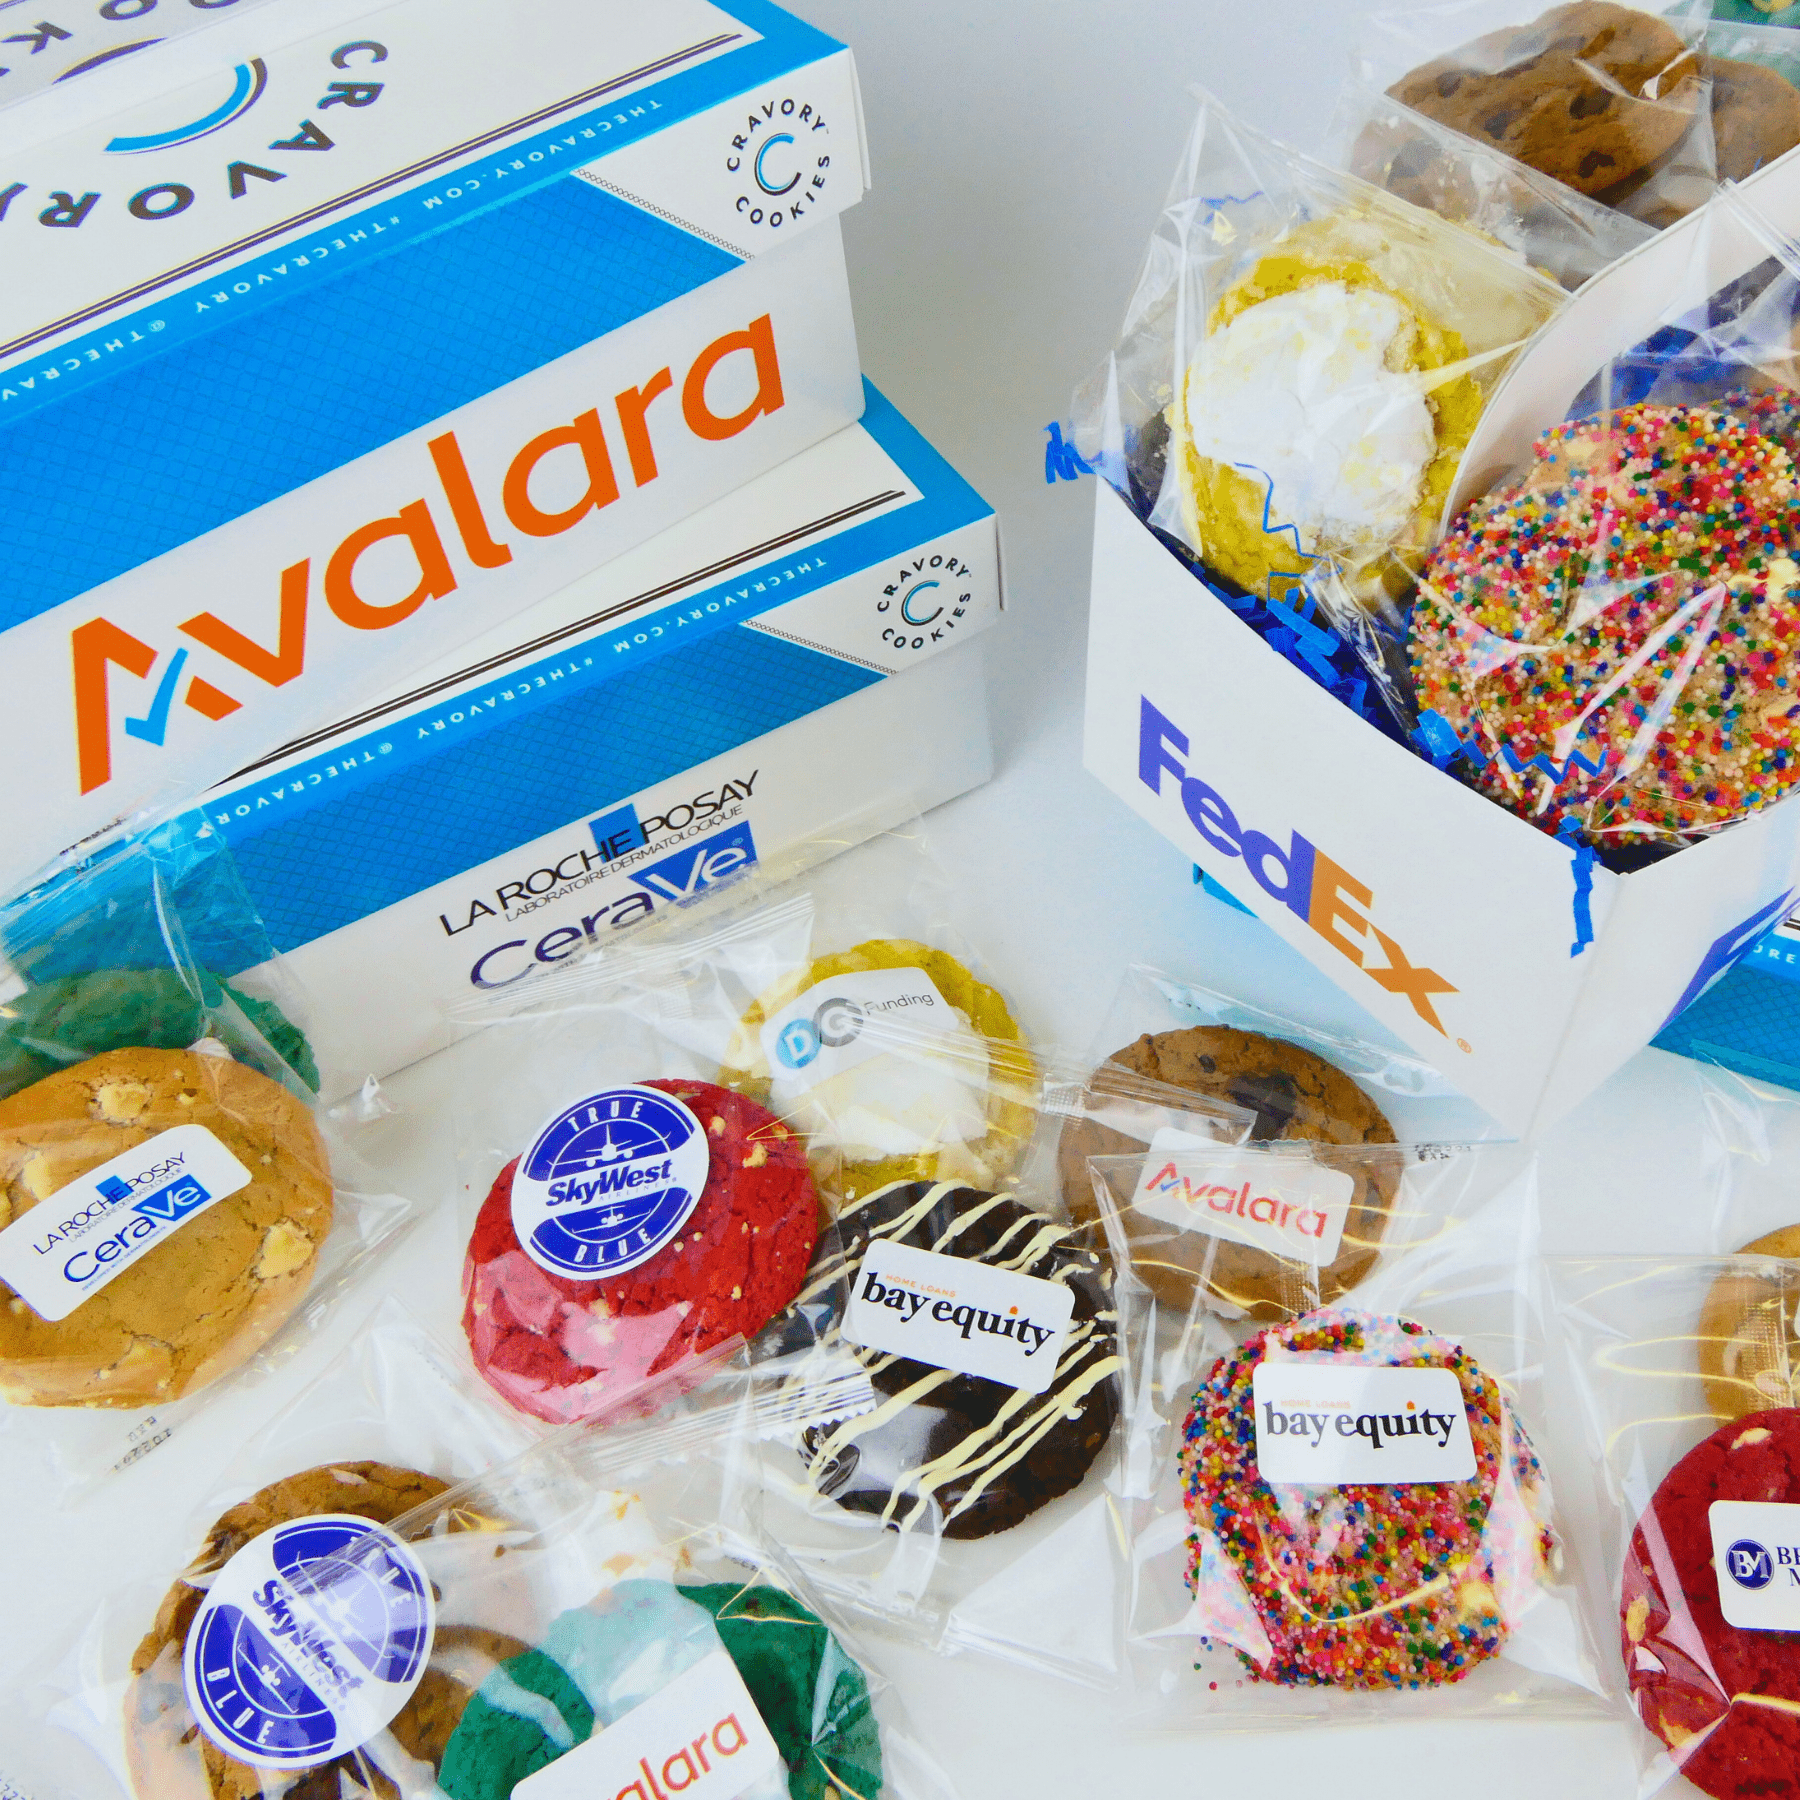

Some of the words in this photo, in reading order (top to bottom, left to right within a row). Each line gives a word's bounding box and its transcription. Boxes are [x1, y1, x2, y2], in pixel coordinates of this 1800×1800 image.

[726, 98, 827, 172] CRAVORY
[736, 155, 830, 228] COOKIES
[71, 312, 785, 797] Avalara
[877, 554, 970, 613] CRAVORY
[881, 592, 971, 650] COOKIES
[439, 899, 497, 936] LA
[496, 828, 636, 911] ROCHE
[639, 769, 759, 844] POSAY
[505, 866, 611, 922] LABORATOIRE
[611, 804, 743, 873] DERMATOLOGIQUE
[1139, 694, 1459, 1039] FedEx
[470, 847, 748, 990] CeraVe
[864, 993, 935, 1015] Funding
[567, 1100, 643, 1132] TRUE
[33, 1233, 64, 1255] LA
[58, 1186, 126, 1237] ROCHE
[124, 1151, 185, 1193] POSAY
[545, 1158, 673, 1206] SkyWest
[1144, 1161, 1328, 1238] Avalara
[63, 1186, 202, 1283] CeraVe
[573, 1228, 651, 1263] BLUE
[861, 1271, 931, 1323] bay
[931, 1300, 1055, 1357] equity
[885, 1274, 916, 1288] HOME
[920, 1284, 957, 1298] LOANS
[1262, 1401, 1330, 1448] bay
[1335, 1400, 1457, 1449] equity
[206, 1667, 275, 1744] BLUE
